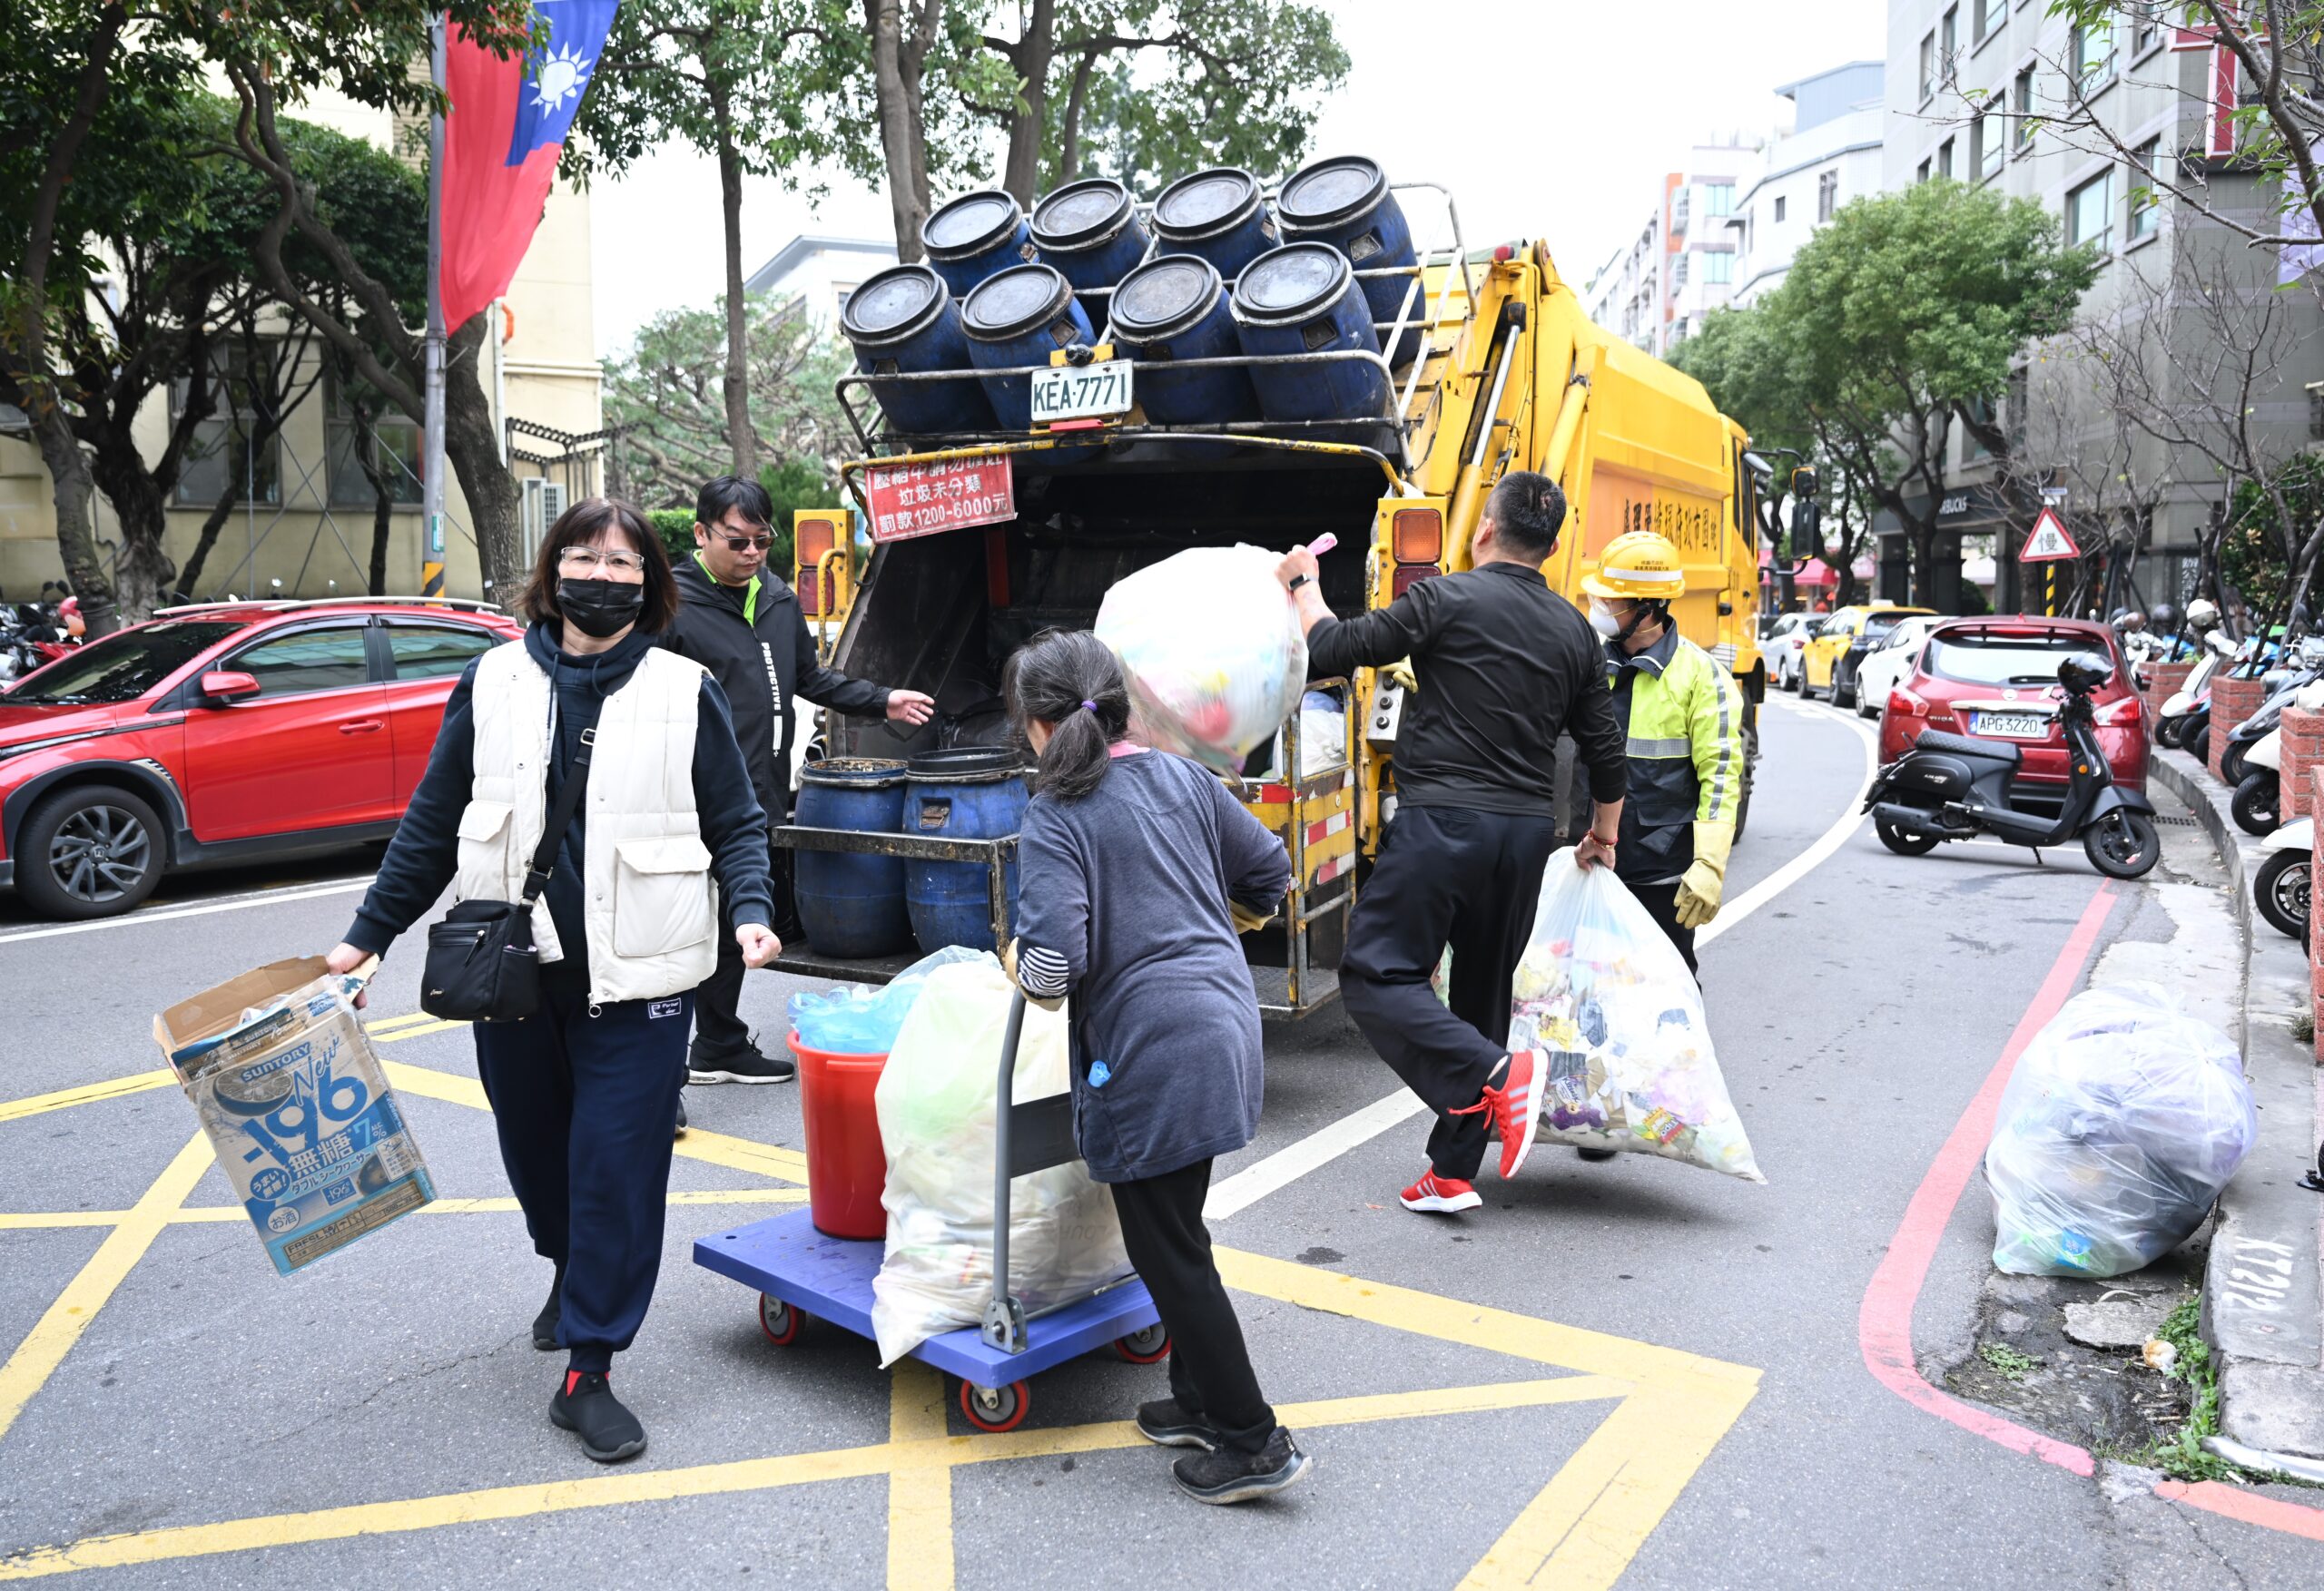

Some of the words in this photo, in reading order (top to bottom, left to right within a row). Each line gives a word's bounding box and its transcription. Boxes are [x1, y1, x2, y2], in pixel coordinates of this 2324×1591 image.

[1033, 373, 1126, 413] KEA-7771
[898, 474, 982, 507] 垃圾未分類
[878, 493, 1008, 534] 罰款1200-6000元
[2038, 533, 2057, 552] 慢
[761, 642, 782, 711] PROTECTIVE
[293, 1036, 340, 1107] New
[352, 1117, 371, 1147] 7
[289, 1130, 355, 1180] 無糖
[253, 1170, 280, 1193] うまい
[271, 1210, 297, 1231] お酒
